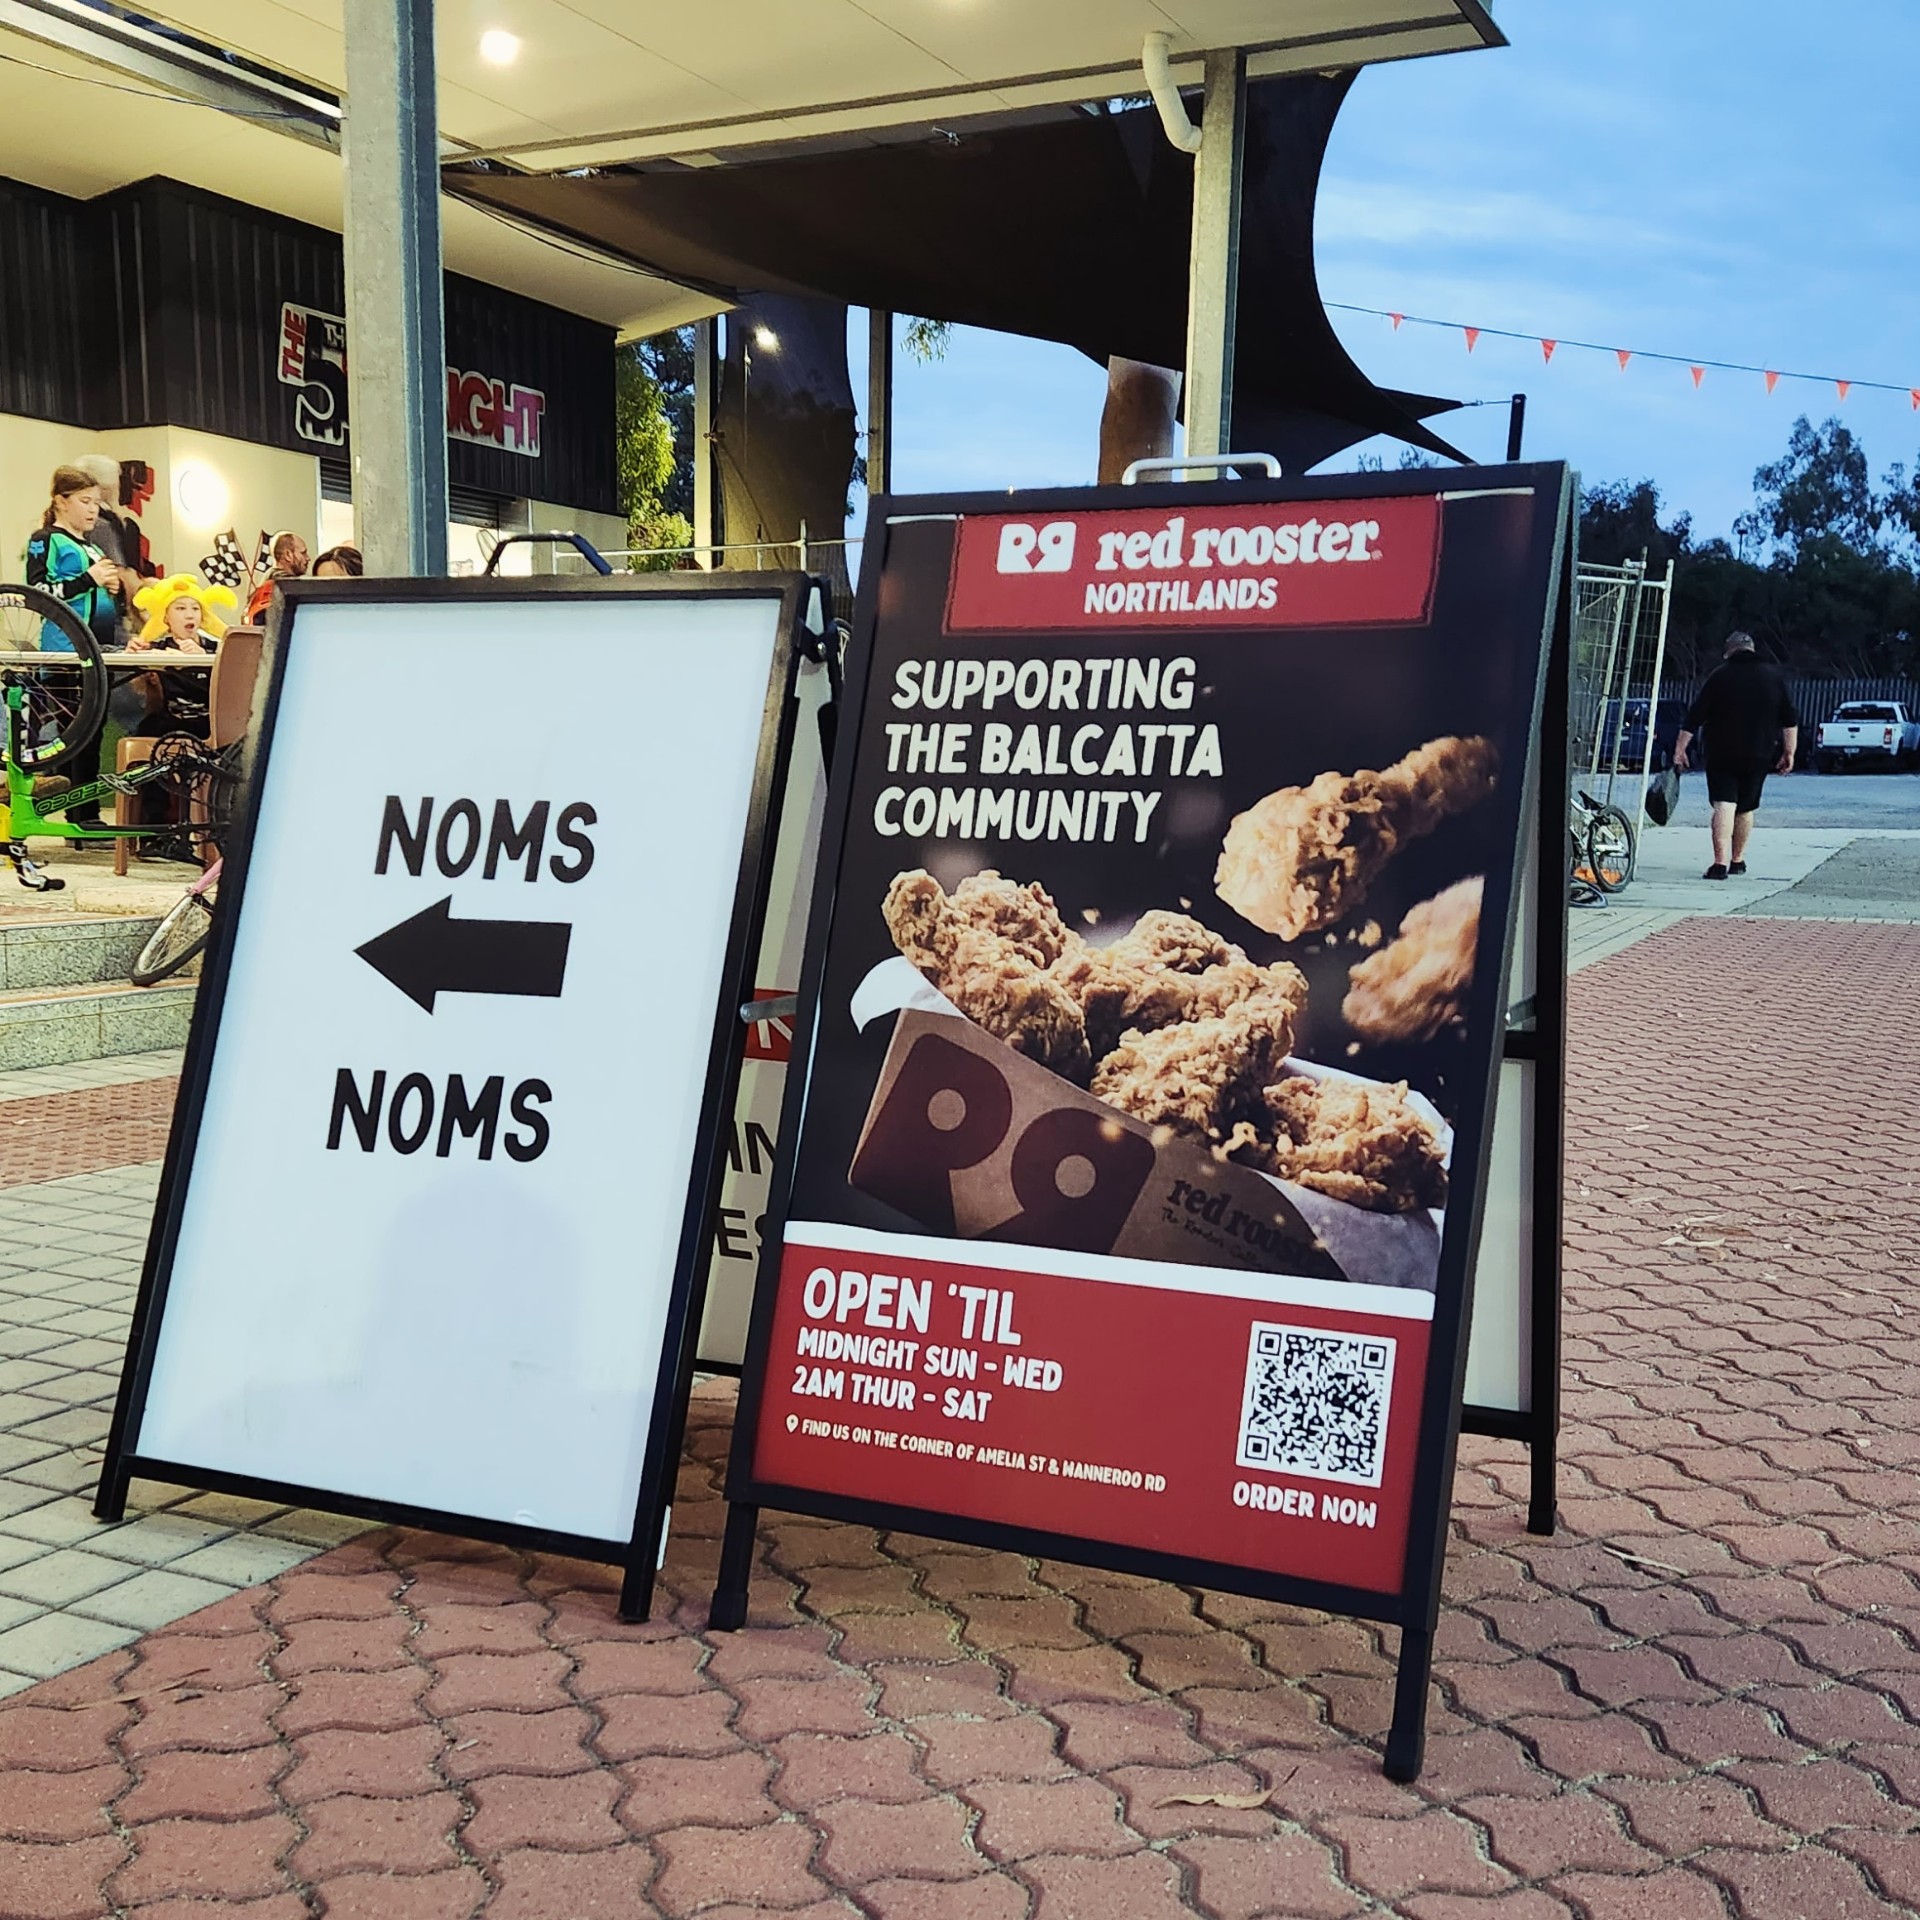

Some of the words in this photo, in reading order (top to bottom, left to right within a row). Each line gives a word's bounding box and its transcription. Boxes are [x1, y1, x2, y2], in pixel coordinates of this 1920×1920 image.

[282, 308, 305, 379] THE
[447, 372, 545, 447] IGHT
[1095, 516, 1185, 571] red
[1189, 517, 1380, 568] rooster
[1084, 577, 1279, 614] NORTHLANDS
[891, 656, 1196, 711] SUPPORTING
[885, 722, 970, 775] THE
[979, 722, 1224, 777] BALCATTA
[374, 795, 598, 884] NOMS
[873, 786, 1162, 843] COMMUNITY
[326, 1068, 553, 1163] NOMS
[803, 1267, 933, 1334] OPEN
[797, 1326, 920, 1371] MIDNIGHT
[923, 1345, 978, 1381] SUN
[1002, 1354, 1063, 1392] WED
[791, 1365, 845, 1400] 2AM
[851, 1372, 916, 1411] THUR
[942, 1387, 993, 1422] SAT
[801, 1418, 831, 1438] FIND
[832, 1423, 850, 1441] US
[852, 1426, 872, 1445] ON
[873, 1429, 899, 1449] THE
[899, 1434, 954, 1458] CORNER
[956, 1443, 975, 1461] OF
[975, 1447, 1026, 1470] AMELIA
[1028, 1454, 1047, 1473] ST
[1047, 1458, 1060, 1476] &
[1062, 1459, 1143, 1489] WANNEROO
[1144, 1473, 1166, 1492] RD
[1232, 1480, 1315, 1518] ORDER
[1321, 1494, 1377, 1529] NOW
